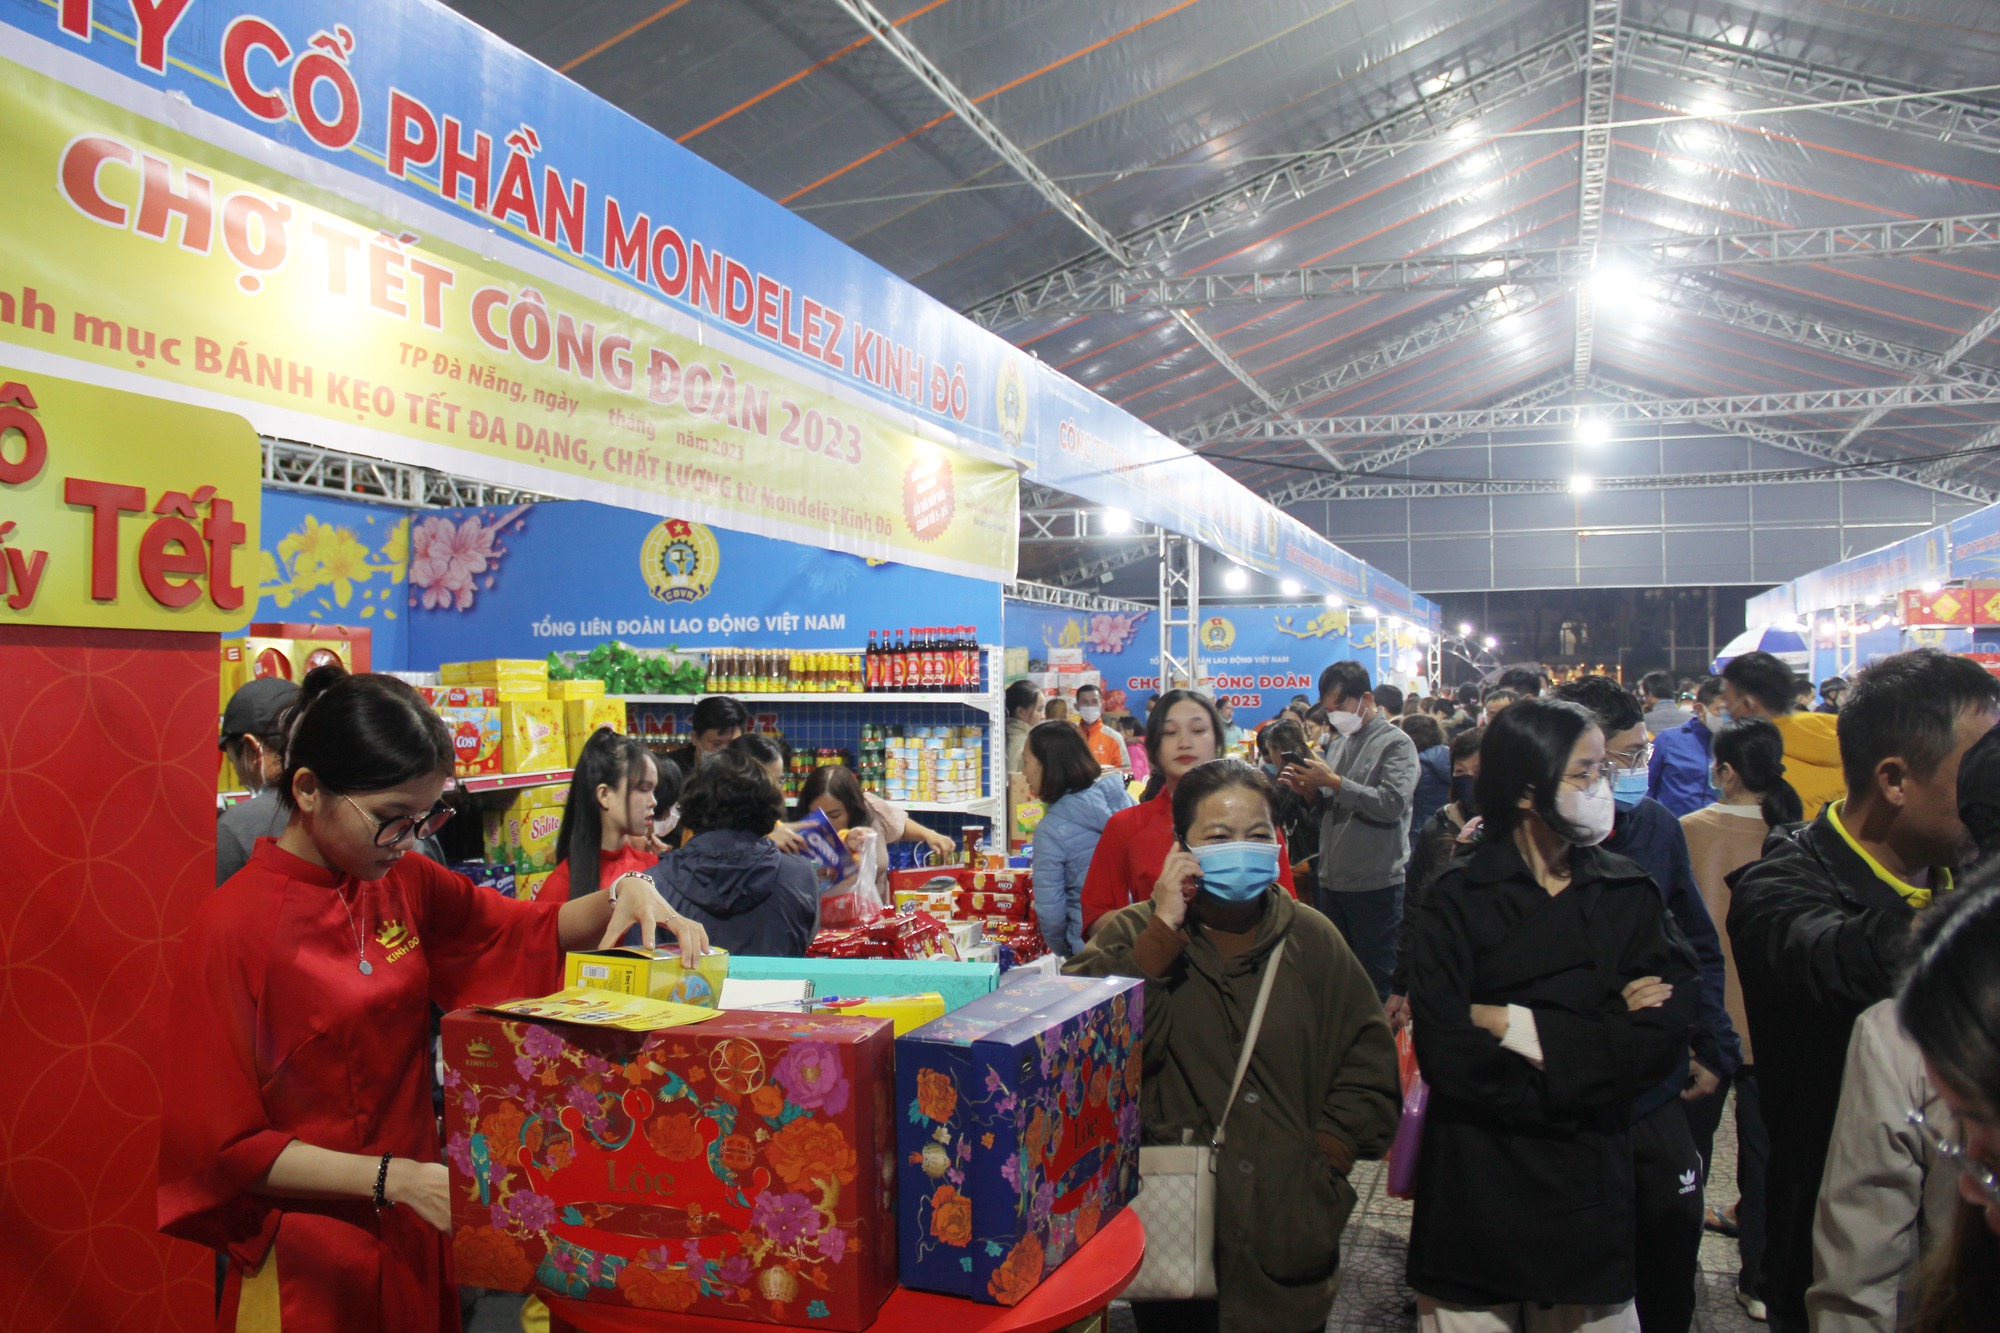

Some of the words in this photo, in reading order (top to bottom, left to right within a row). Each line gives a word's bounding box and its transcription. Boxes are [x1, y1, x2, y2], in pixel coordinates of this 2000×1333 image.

[221, 15, 362, 151] CỔ
[386, 88, 587, 256] PHẦN
[604, 196, 845, 368] MONDELEZ
[852, 323, 923, 406] KINH
[931, 363, 969, 422] ĐÔ
[59, 134, 291, 293] CHỢ
[312, 222, 454, 330] TẾT
[471, 288, 634, 391] CÔNG
[648, 348, 770, 436] ĐOÀN
[780, 400, 862, 465] 2023
[400, 342, 428, 368] TP
[433, 353, 461, 380] Đà
[468, 363, 527, 403] Nẵng,
[533, 388, 579, 417] ngày
[608, 408, 656, 441] tháng
[677, 430, 709, 452] năm
[712, 438, 743, 461] 2023
[73, 312, 181, 368] mục
[194, 340, 313, 397] BÁNH
[327, 371, 395, 421] KẸO
[405, 391, 461, 434] TẾT
[468, 410, 507, 446] ĐA
[516, 422, 597, 471] DẠNG,
[603, 446, 660, 482] CHẤT
[737, 481, 757, 504] từ
[841, 505, 872, 533] Kinh
[875, 515, 893, 537] Đô
[0, 520, 49, 610] y
[64, 477, 246, 609] Tết
[532, 615, 577, 637] TỔNG
[581, 614, 612, 635] LIÊN
[616, 615, 665, 635] ĐOÀN
[670, 618, 703, 634] LAO
[708, 613, 760, 637] ĐỘNG
[765, 612, 799, 635] VIỆT
[804, 614, 845, 631] NAM
[1259, 671, 1311, 688] ĐOÀN
[456, 735, 478, 748] COSY
[1022, 807, 1041, 818] Solite
[531, 815, 560, 840] Solite
[386, 945, 410, 963] KINH
[408, 936, 419, 949] DO
[606, 1160, 676, 1201] Lộc
[1679, 1184, 1696, 1194] adida
